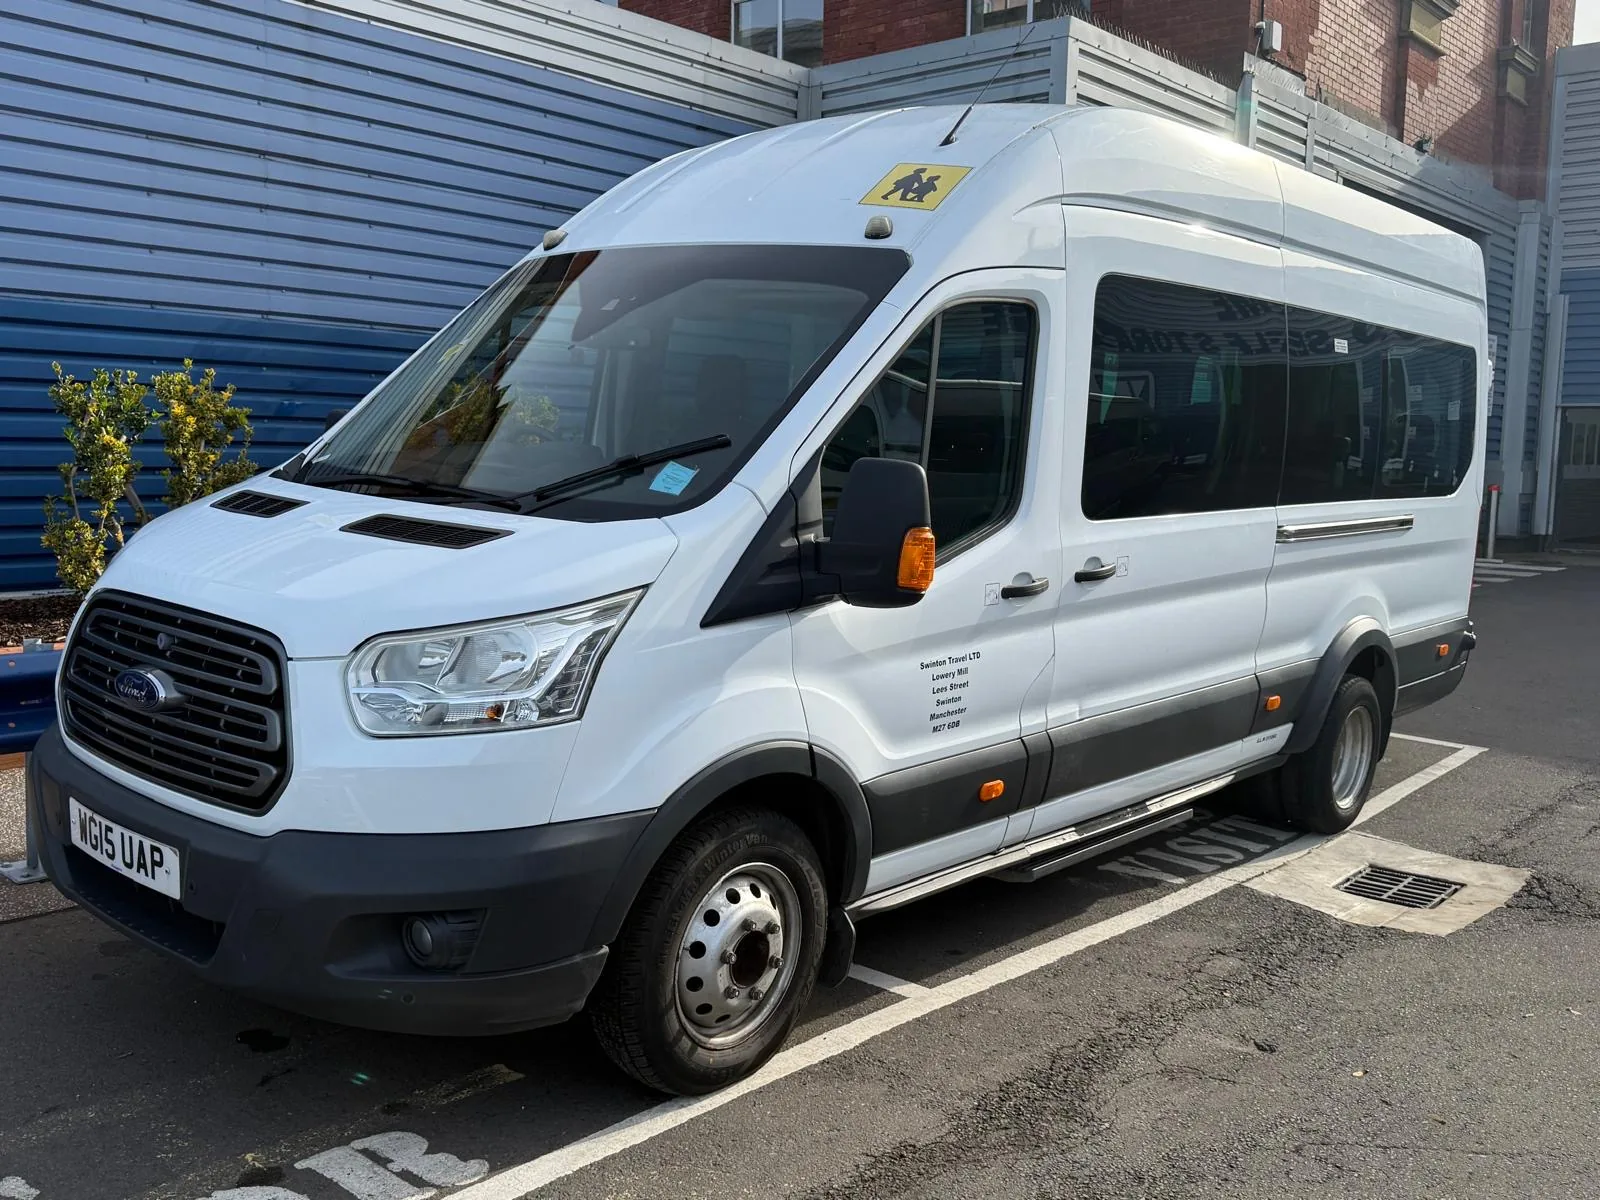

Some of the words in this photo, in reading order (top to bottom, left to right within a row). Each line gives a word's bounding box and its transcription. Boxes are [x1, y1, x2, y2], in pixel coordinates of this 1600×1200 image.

[920, 660, 947, 670] Swinton
[947, 653, 968, 664] Travel
[968, 651, 981, 660] LTD
[931, 671, 956, 681] Lowery
[957, 667, 969, 676] Mill
[932, 686, 948, 694] Lees
[949, 681, 969, 691] Street
[935, 695, 962, 707] Swinton
[929, 707, 967, 721] Manchester
[932, 723, 946, 733] M27
[947, 720, 961, 730] 6DB
[78, 808, 116, 861] WG15
[120, 831, 164, 881] UAP
